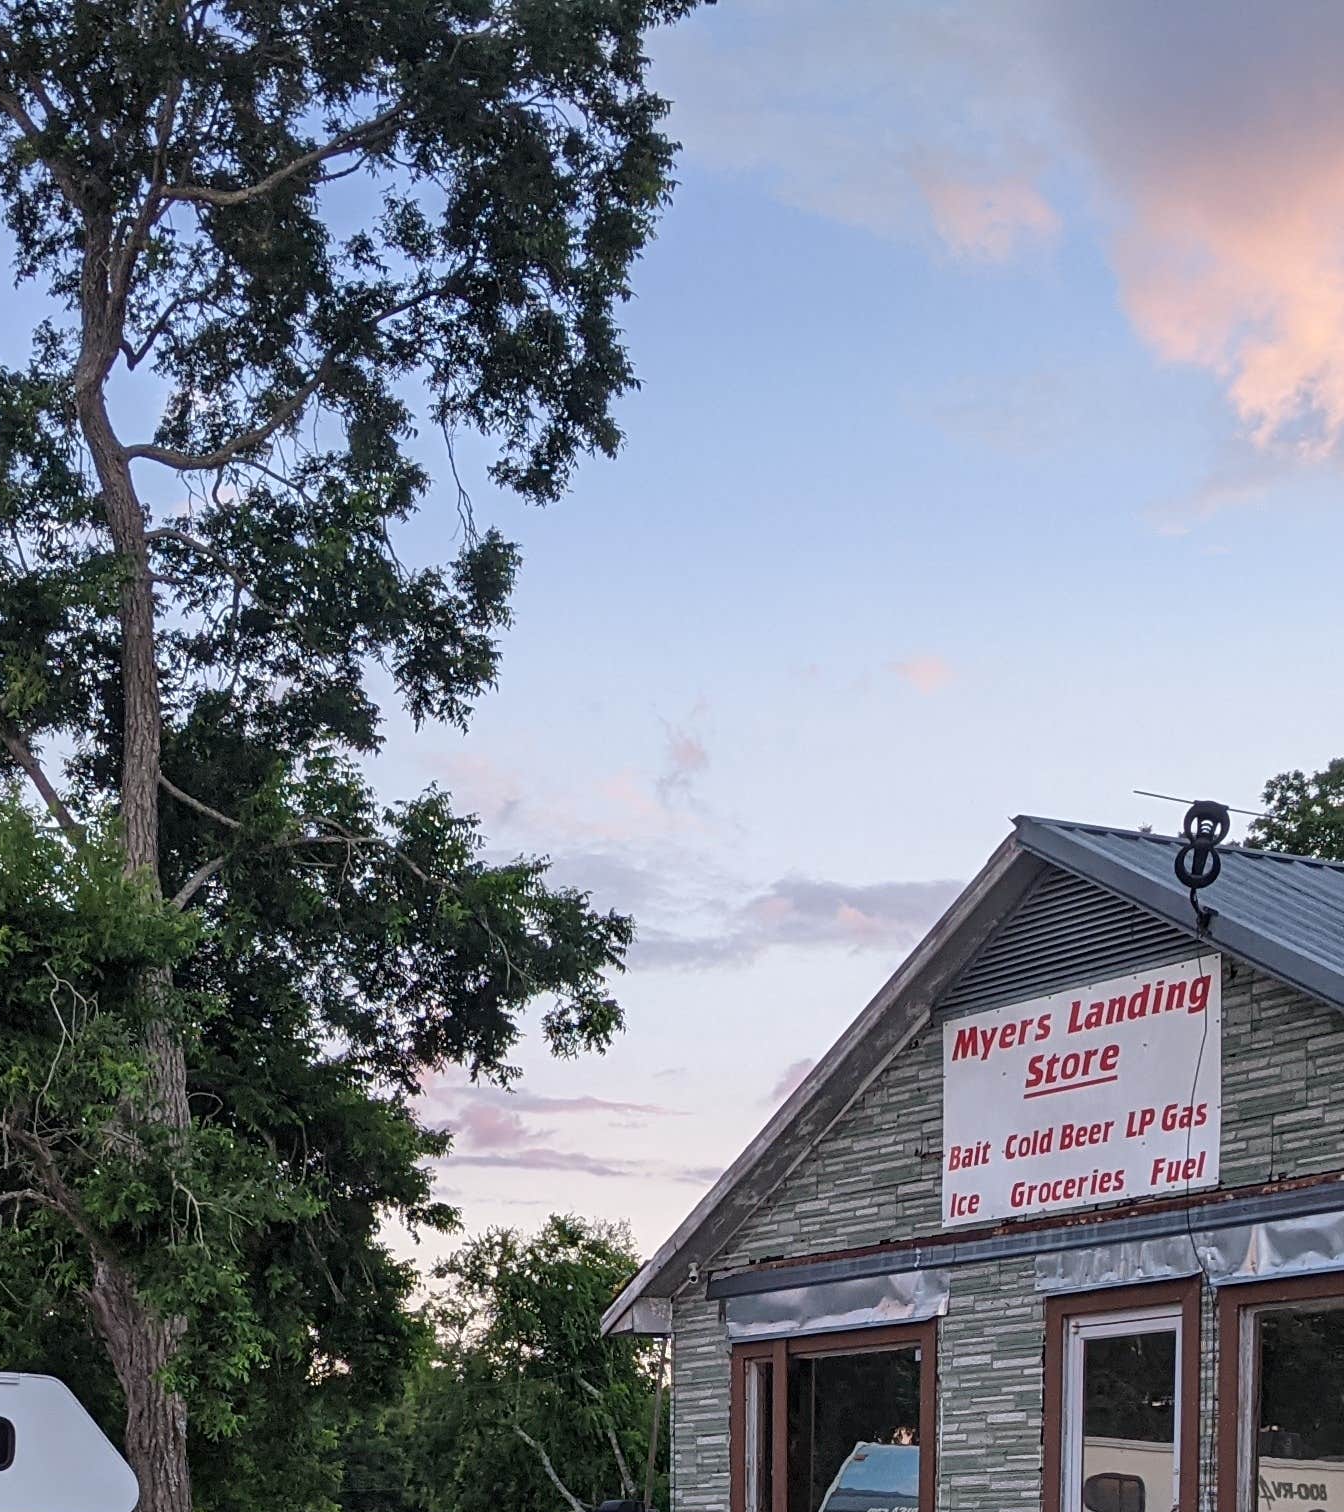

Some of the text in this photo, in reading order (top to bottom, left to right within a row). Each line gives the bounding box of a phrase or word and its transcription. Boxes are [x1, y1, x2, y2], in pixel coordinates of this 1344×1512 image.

[951, 975, 1212, 1061] Myers Landing
[1025, 1043, 1120, 1088] Store
[948, 1103, 1208, 1171] Bait Cold Beer LP Gas
[950, 1151, 1207, 1218] Ice Groceries Fuel
